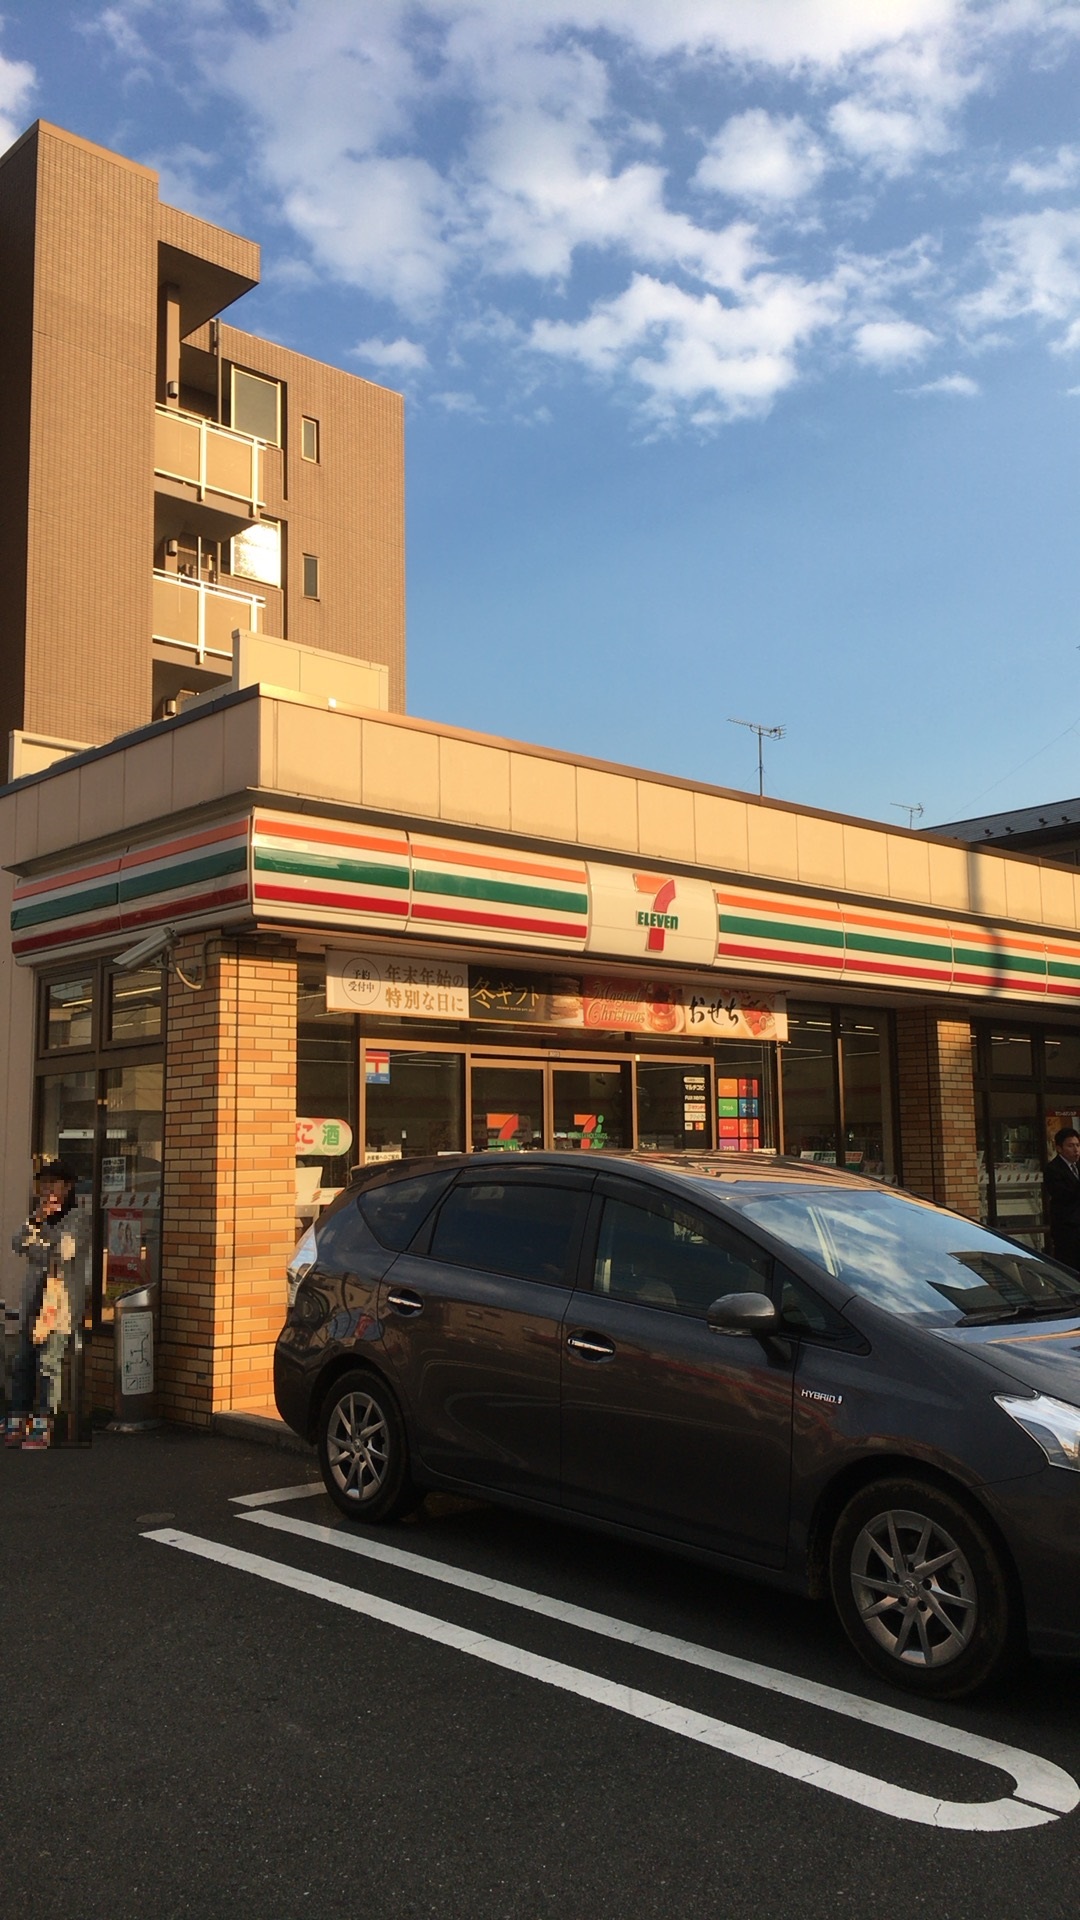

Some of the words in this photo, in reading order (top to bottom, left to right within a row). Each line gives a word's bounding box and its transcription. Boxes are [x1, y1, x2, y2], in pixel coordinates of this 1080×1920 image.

[348, 981, 375, 993] 受付中
[352, 969, 371, 981] 予約
[385, 964, 464, 990] 年末年始の
[385, 987, 464, 1013] 特別な日に
[471, 977, 540, 1009] 冬ギフト
[587, 1001, 646, 1025] Christmas
[689, 995, 739, 1027] おせち
[322, 1124, 340, 1146] 酒
[801, 1389, 836, 1403] HYBRID
